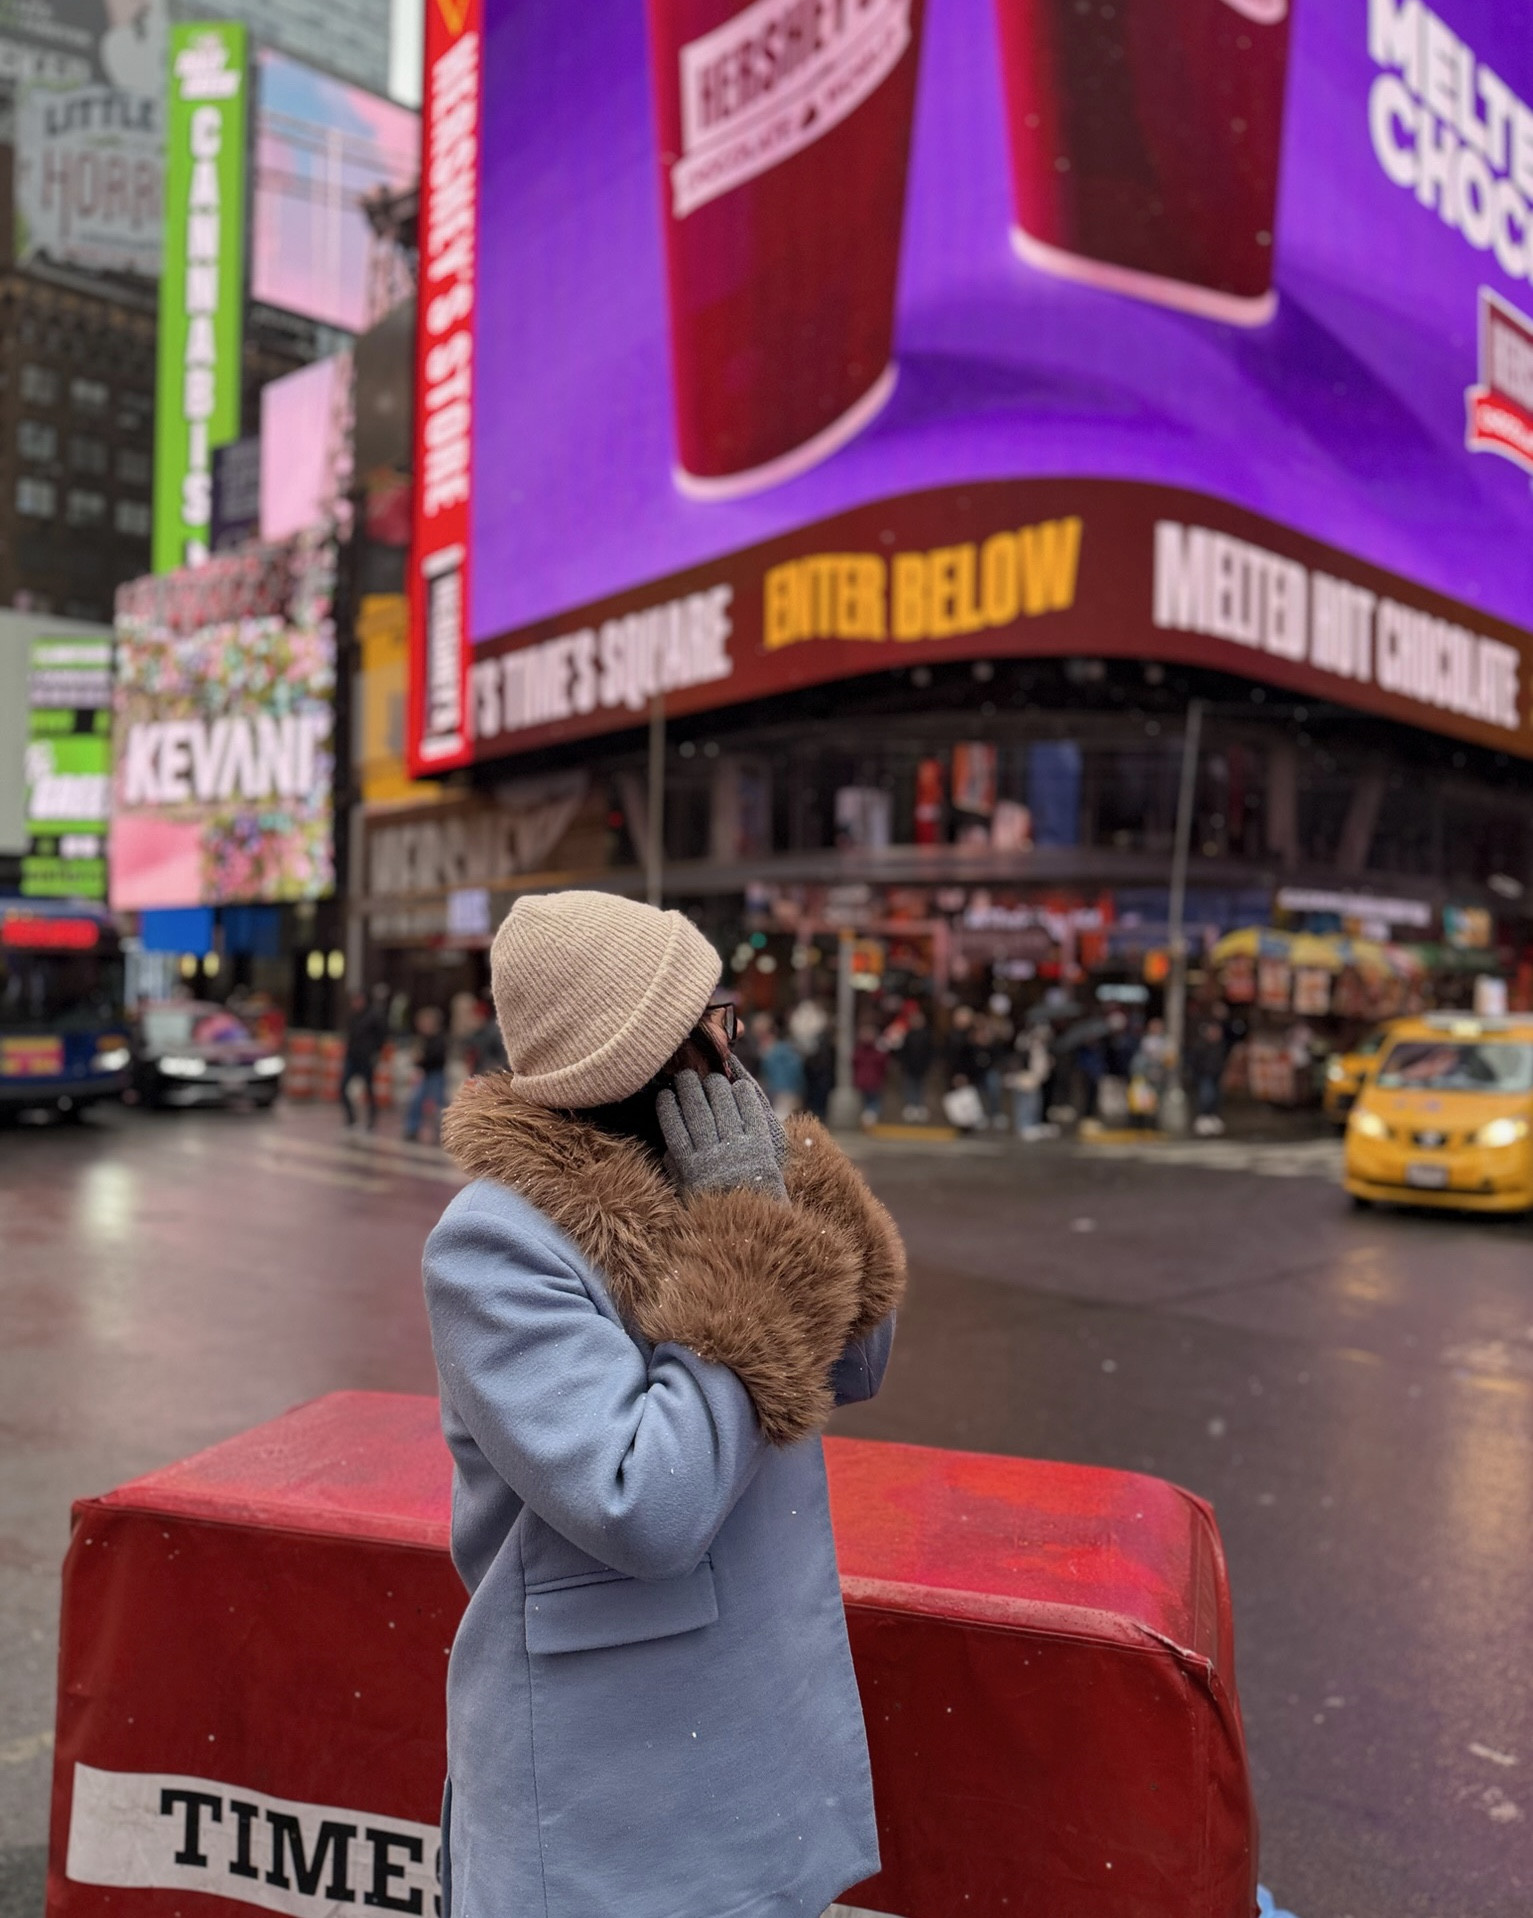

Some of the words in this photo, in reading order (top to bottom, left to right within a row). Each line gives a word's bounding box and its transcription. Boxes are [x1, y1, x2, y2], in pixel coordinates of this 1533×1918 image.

[40, 145, 166, 240] HORR
[1366, 0, 1533, 205] MELTE
[1366, 69, 1533, 288] CHOC
[182, 105, 223, 527] CANNABIS
[762, 551, 887, 650] ENTER
[891, 515, 1082, 643] BELOW
[1152, 519, 1308, 662] MELTED
[1376, 596, 1521, 732] CHOCOLATE
